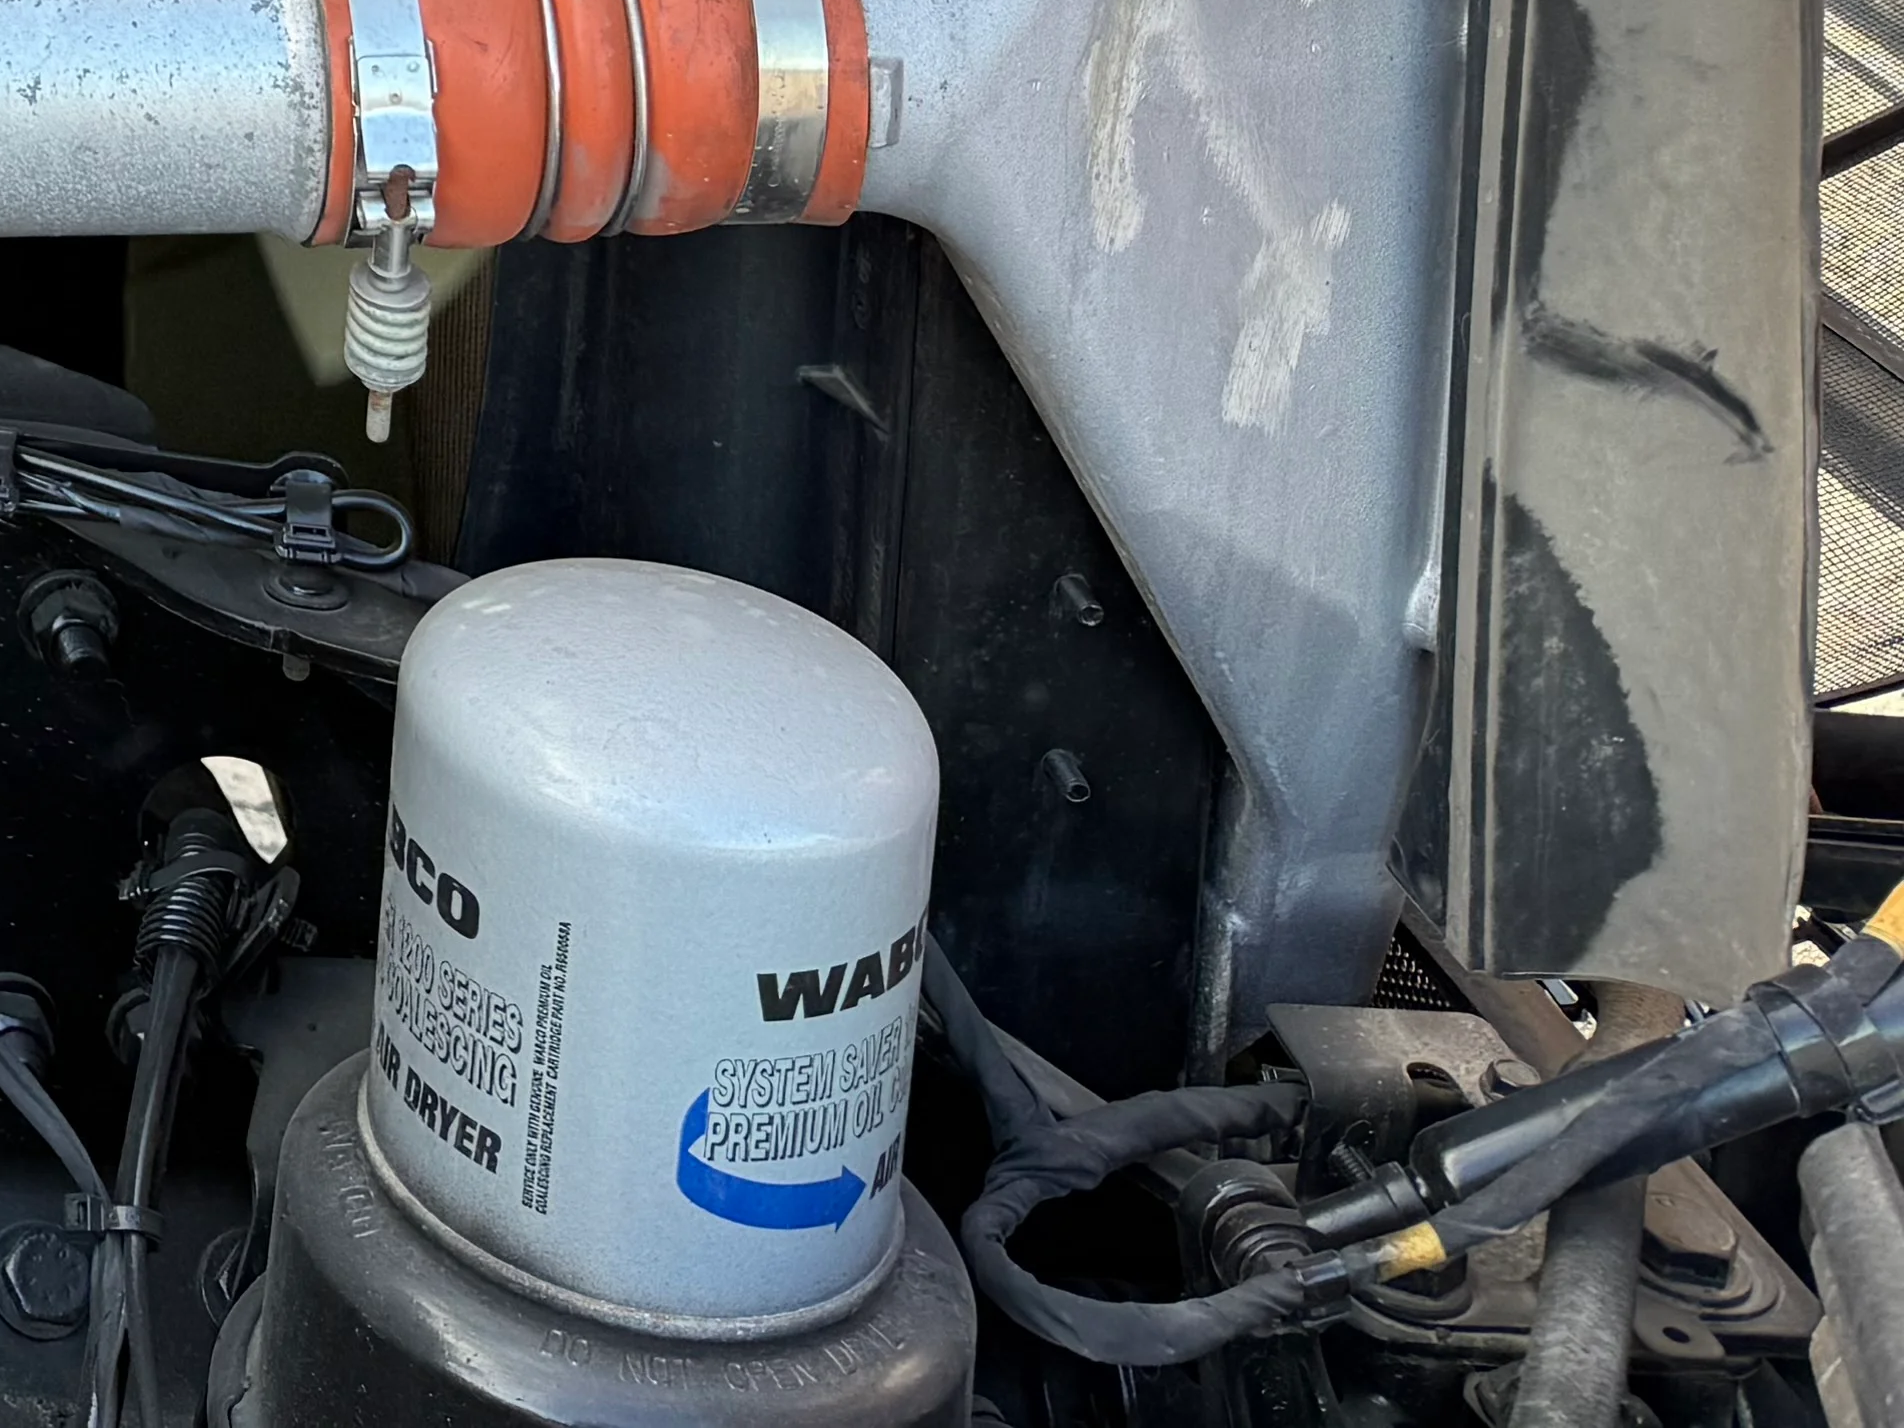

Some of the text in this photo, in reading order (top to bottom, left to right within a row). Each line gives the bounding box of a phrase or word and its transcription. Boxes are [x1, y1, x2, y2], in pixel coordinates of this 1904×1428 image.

[540, 963, 553, 980] OIL
[439, 960, 525, 1055] SERIES
[536, 980, 551, 1029] PREMIUM
[551, 993, 565, 1021] PART
[533, 1030, 547, 1066] WABCO
[546, 1021, 563, 1080] CARTRIDGE
[712, 1049, 835, 1109] SYSTEM
[840, 1016, 902, 1092] SAVER
[375, 1019, 503, 1175] AIR DRYER
[540, 1082, 558, 1154] REPLACEMENT
[527, 1112, 540, 1140] WITH
[704, 1097, 847, 1162] PREMIUM
[852, 1088, 883, 1139] OIL
[525, 1140, 538, 1165] ONLY
[521, 1165, 535, 1209] SERVICE
